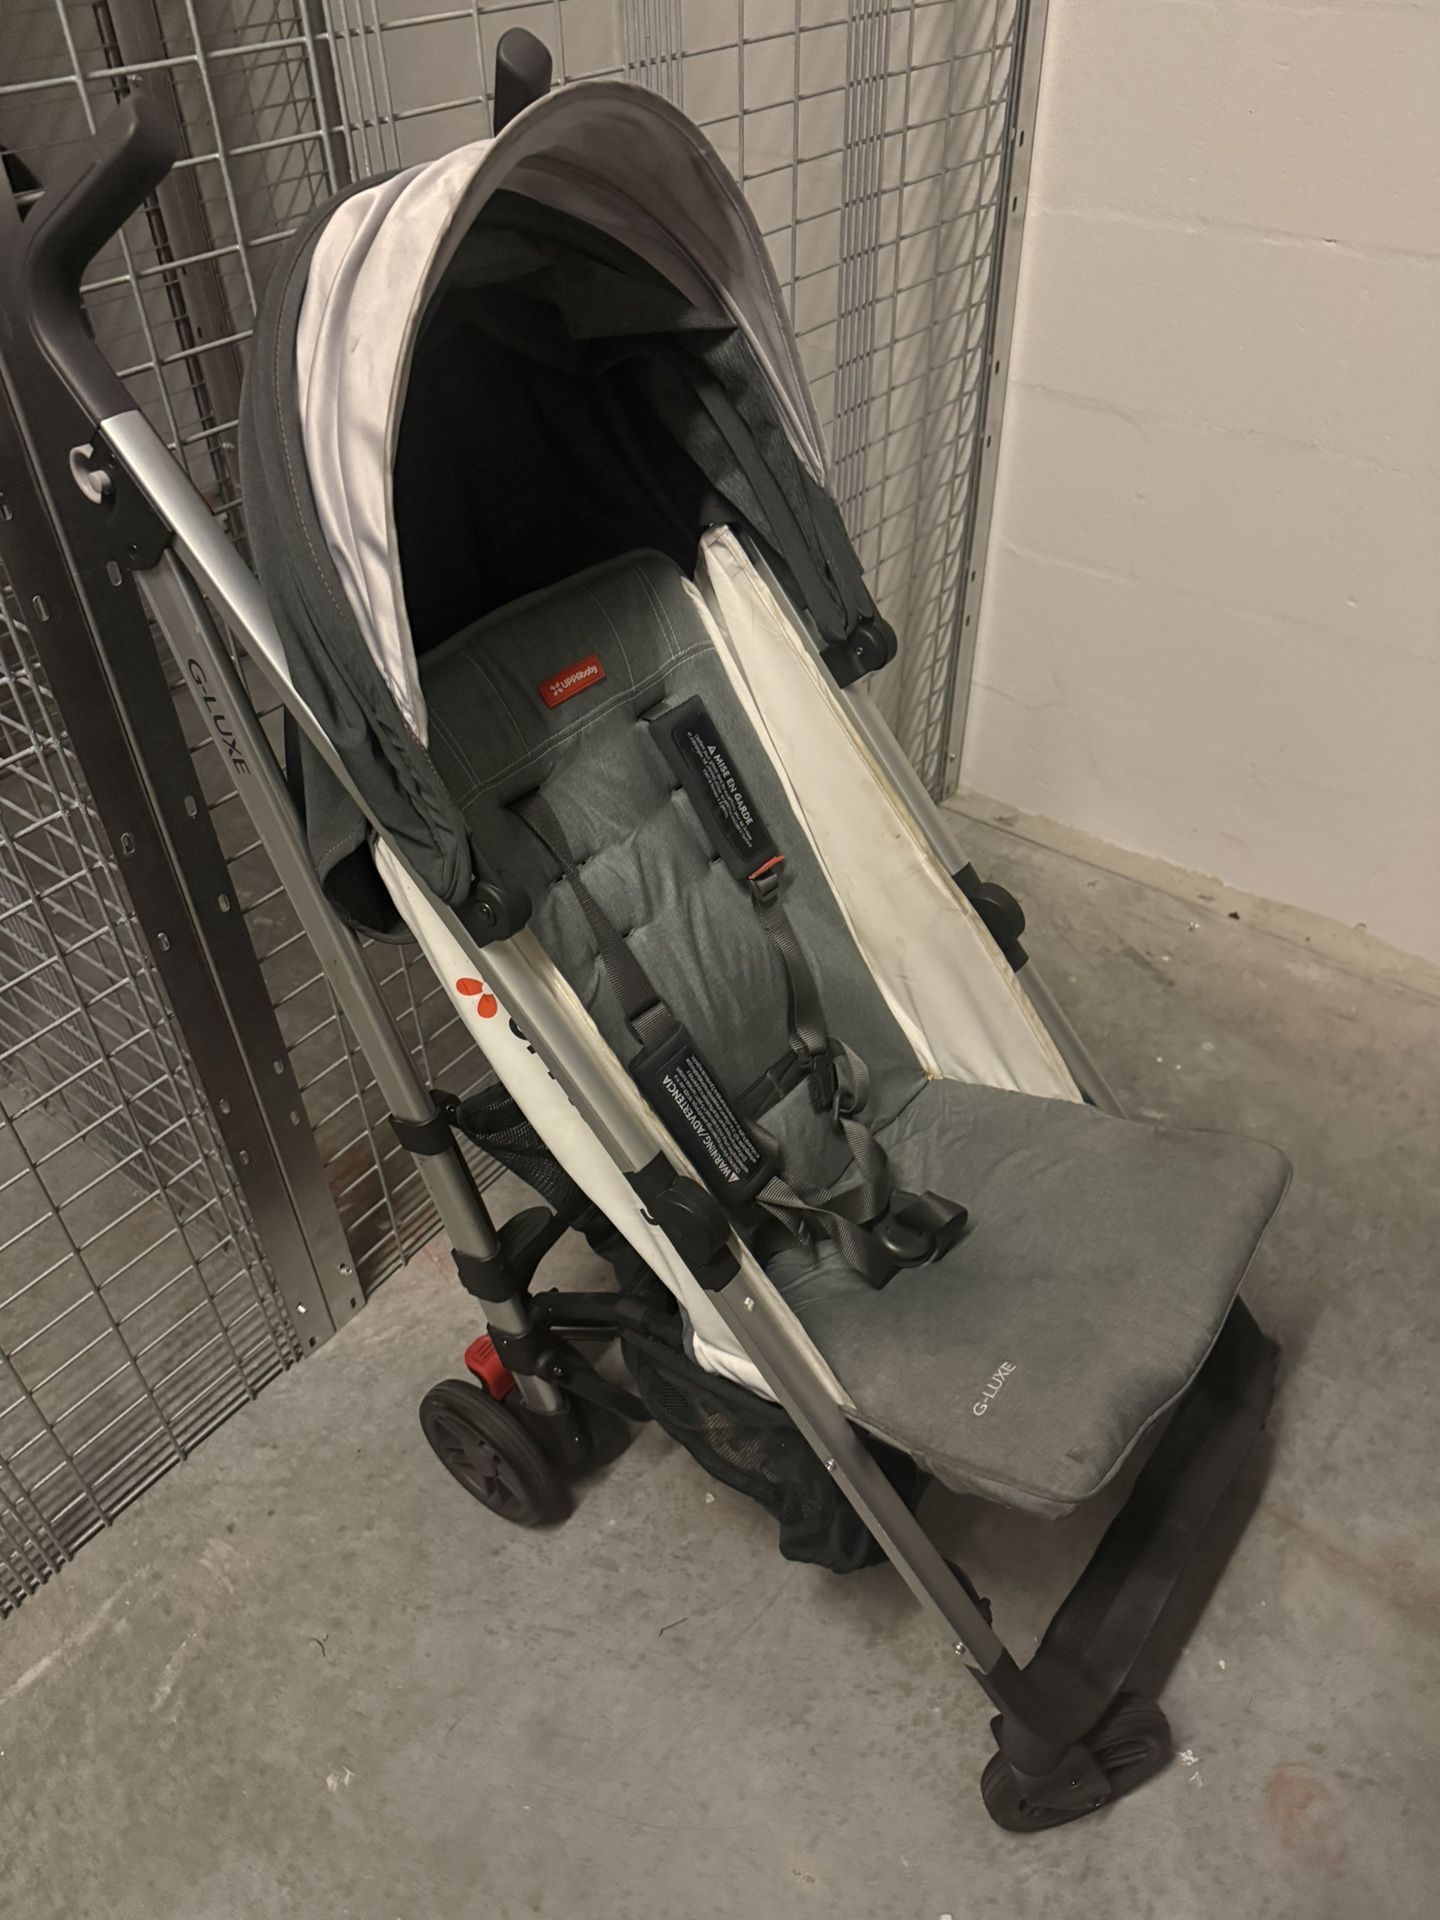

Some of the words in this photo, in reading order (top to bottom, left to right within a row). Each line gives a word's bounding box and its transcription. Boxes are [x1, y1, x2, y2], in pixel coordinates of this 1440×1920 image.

[188, 658, 251, 775] G-LUXE
[713, 754, 731, 778] MISE
[726, 776, 737, 793] EN
[734, 792, 754, 825] GARDE
[662, 1074, 734, 1179] WARNING/ADVERTENCIA
[973, 1361, 1017, 1416] G-LUXE
